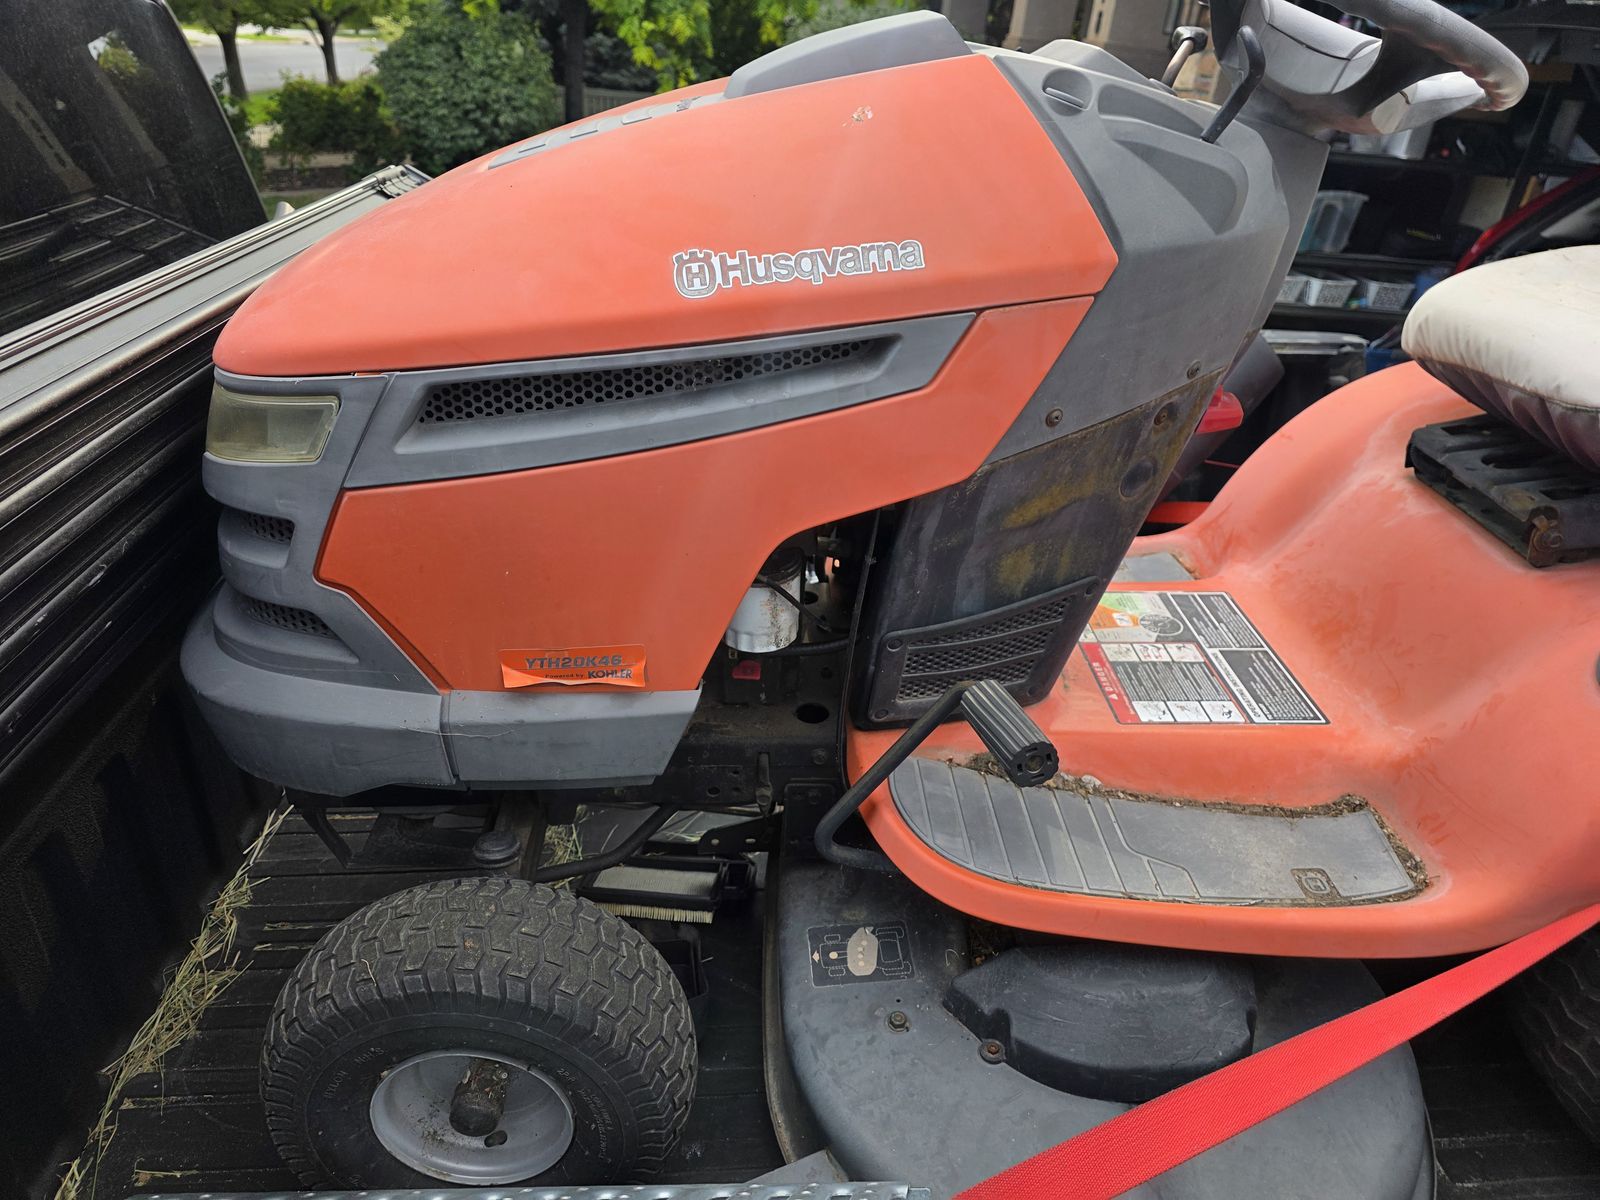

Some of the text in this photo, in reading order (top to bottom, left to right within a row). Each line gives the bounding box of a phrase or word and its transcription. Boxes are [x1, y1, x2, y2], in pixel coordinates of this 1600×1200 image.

[718, 240, 925, 285] Husqvarna
[525, 655, 622, 669] YTH20K46
[587, 669, 632, 679] KOHLER
